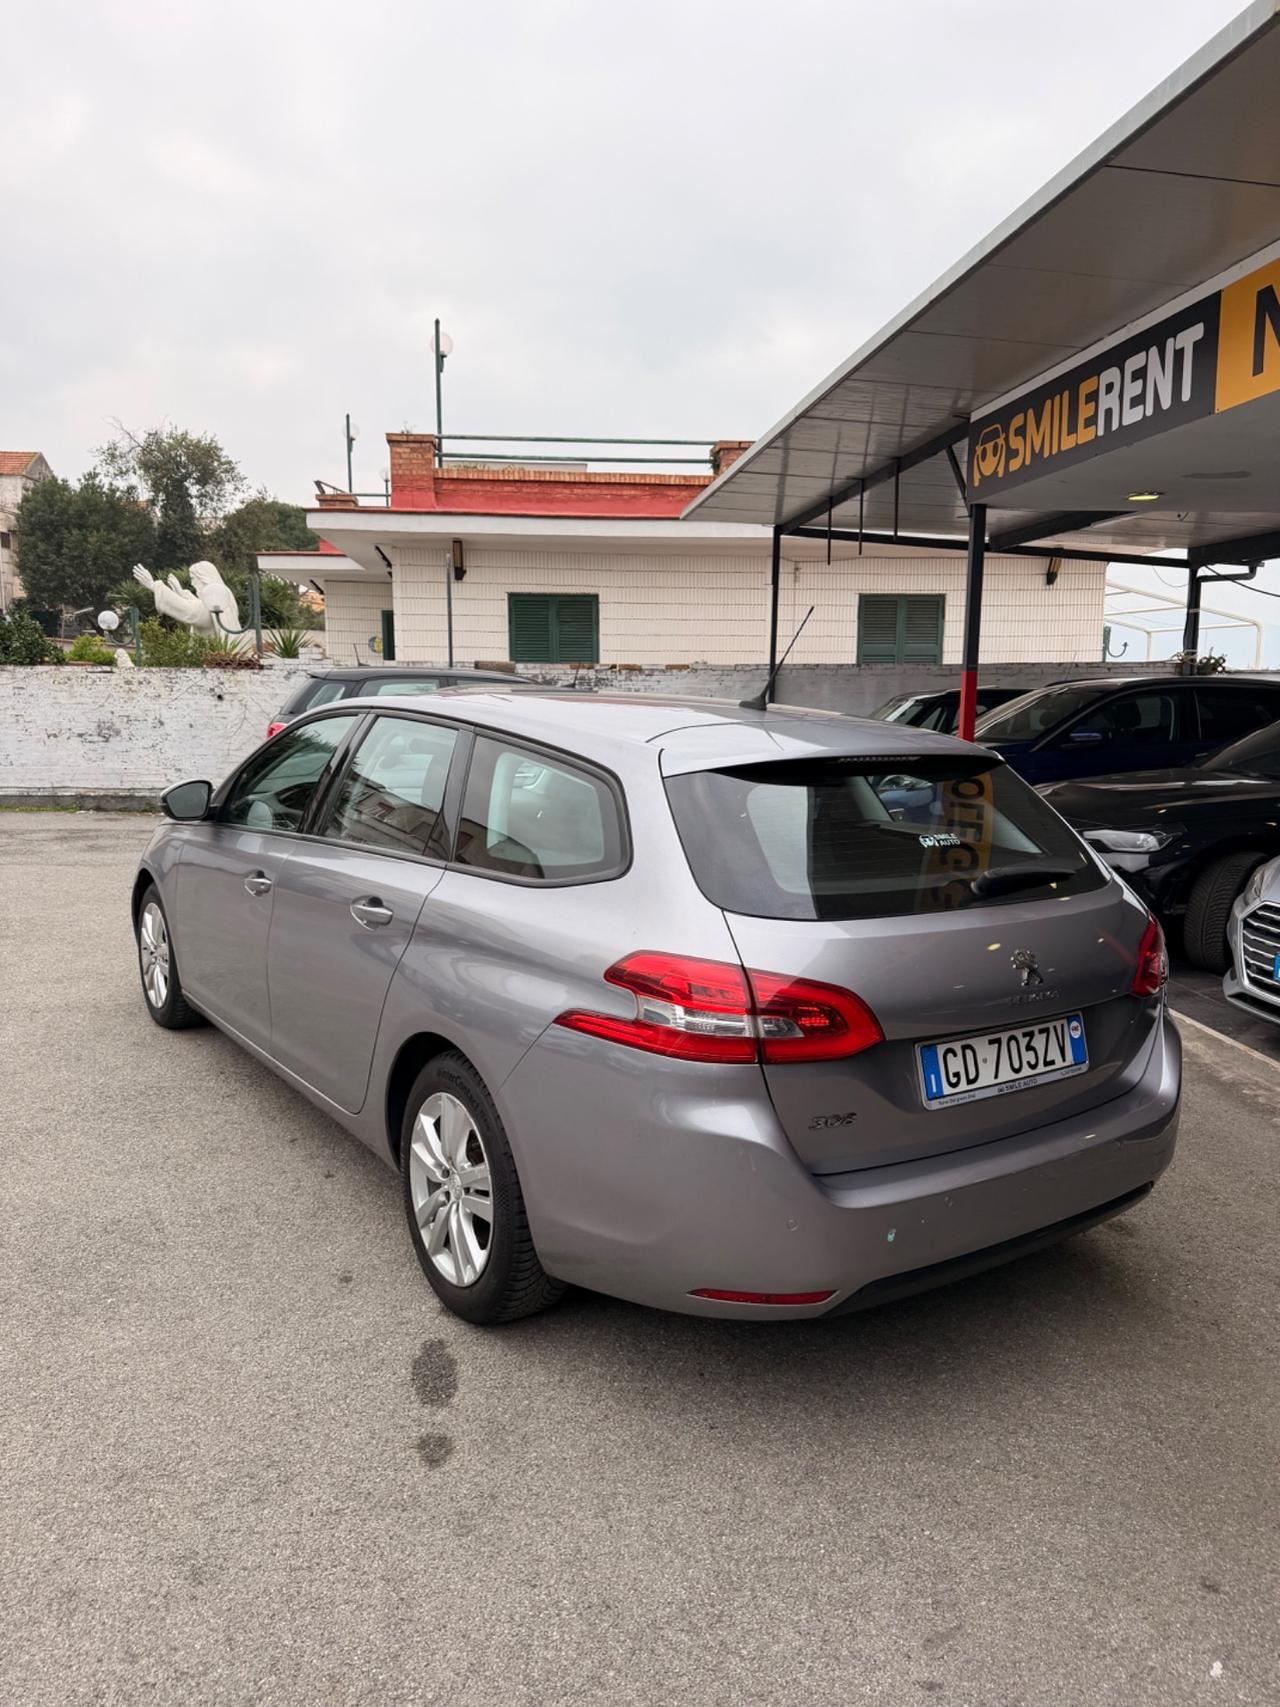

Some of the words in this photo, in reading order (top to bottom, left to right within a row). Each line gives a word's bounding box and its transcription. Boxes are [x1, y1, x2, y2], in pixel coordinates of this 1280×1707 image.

[1008, 322, 1204, 473] SMILERENT
[939, 839, 961, 847] AUTO
[942, 1043, 980, 1089] GD
[988, 1023, 1067, 1080] 703ZV
